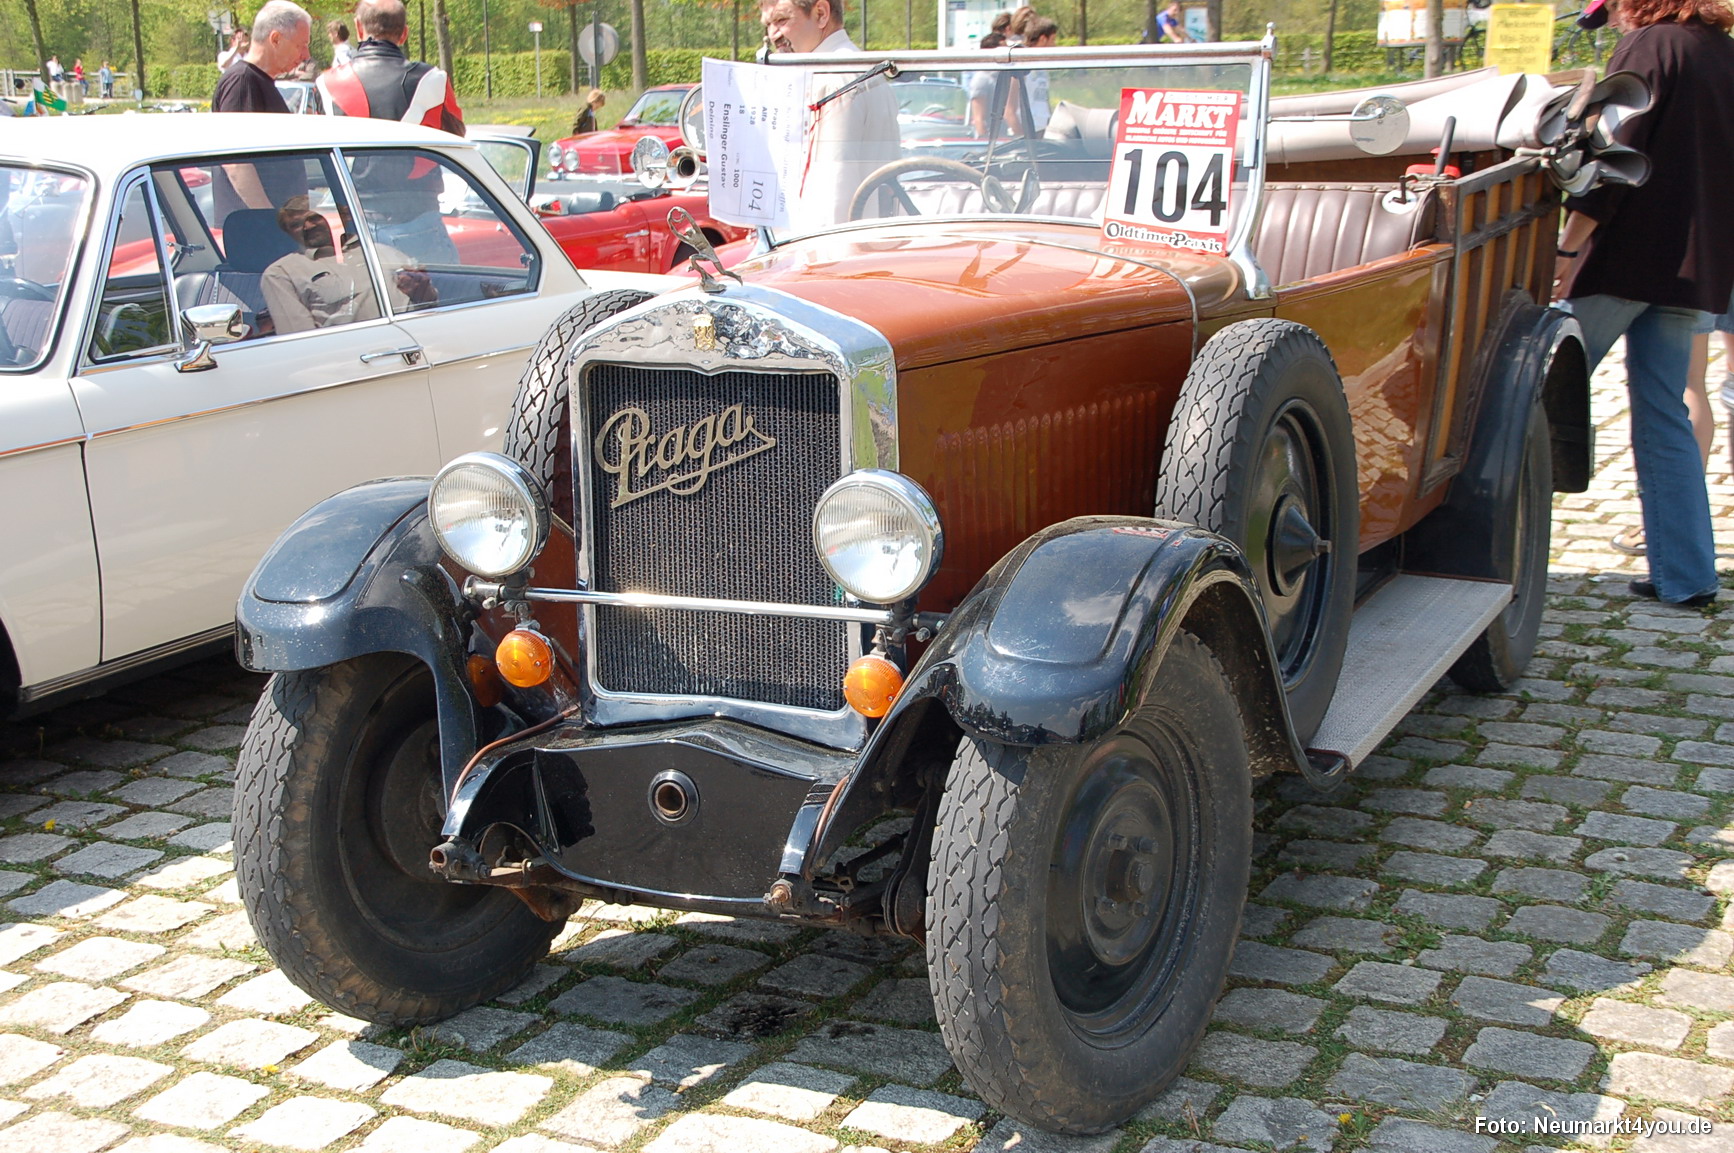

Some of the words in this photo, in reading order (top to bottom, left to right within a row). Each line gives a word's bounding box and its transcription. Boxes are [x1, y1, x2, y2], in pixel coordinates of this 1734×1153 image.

[738, 104, 746, 115] 18
[749, 106, 757, 125] 1928
[771, 107, 779, 130] Praga
[1125, 91, 1234, 129] MARKT
[720, 103, 732, 151] Enslinger
[720, 153, 728, 189] Gustav
[732, 168, 740, 188] 1000
[749, 180, 764, 212] 104
[1123, 148, 1227, 227] 104
[1106, 222, 1221, 252] OldtimerPraxis
[594, 402, 777, 509] Praga
